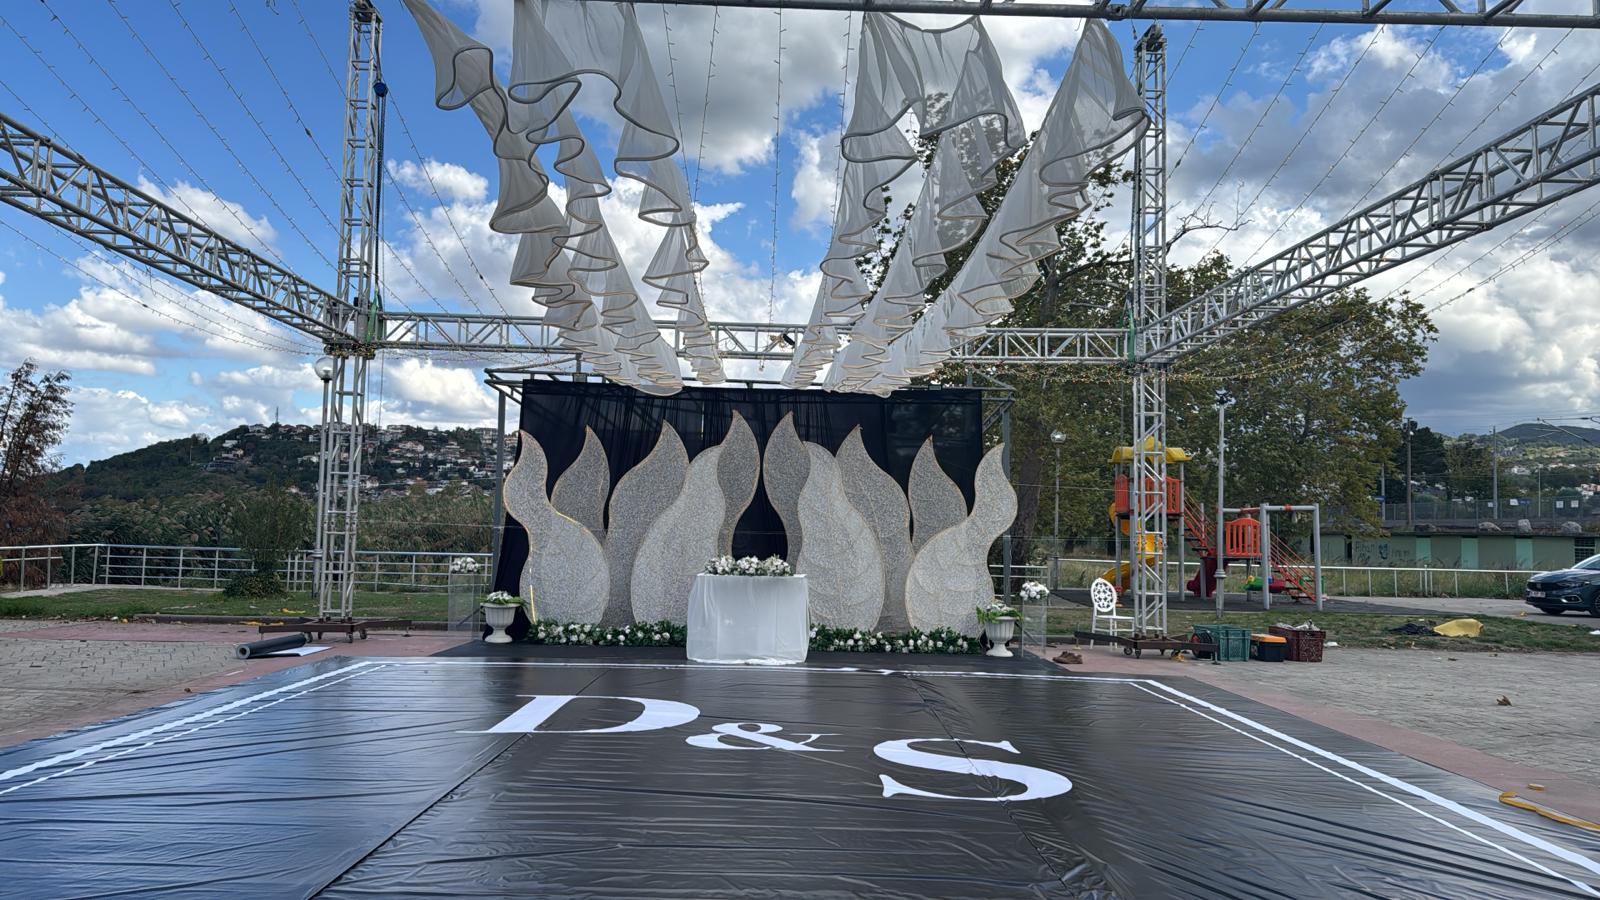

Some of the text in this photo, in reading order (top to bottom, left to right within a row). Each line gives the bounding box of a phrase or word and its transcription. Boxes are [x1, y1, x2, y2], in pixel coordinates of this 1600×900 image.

[456, 695, 1073, 802] D & S
